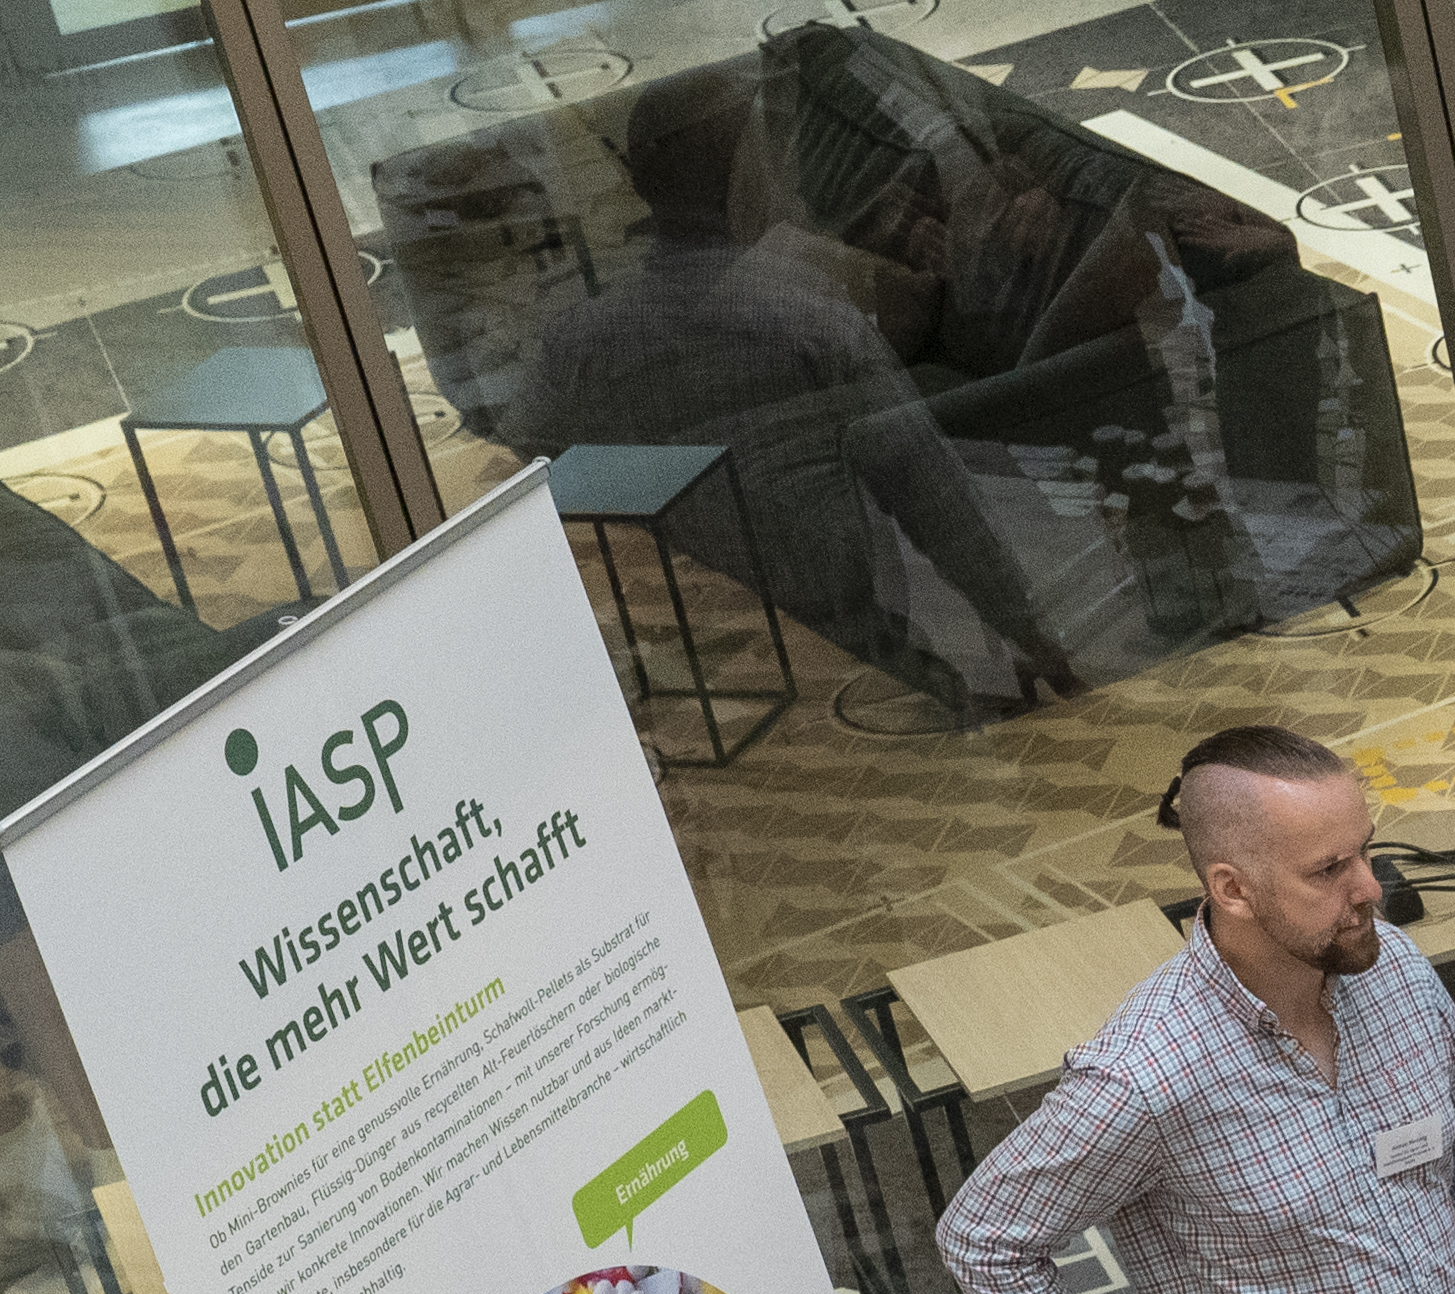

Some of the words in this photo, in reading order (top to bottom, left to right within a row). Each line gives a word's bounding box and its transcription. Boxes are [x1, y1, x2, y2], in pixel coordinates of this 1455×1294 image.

[199, 1052, 262, 1118] die
[264, 974, 362, 1071] mehr
[360, 900, 462, 993] Wert
[462, 808, 587, 927] schafft
[237, 797, 503, 1000] Wissenschaft,
[193, 1121, 310, 1218] Innovation
[311, 1078, 363, 1132] statt
[361, 975, 506, 1093] Elfenbeinturm
[207, 1229, 228, 1250] Ob
[226, 1167, 312, 1236] Mini-Brownies
[310, 1152, 329, 1173] für
[330, 1133, 356, 1159] eine
[356, 1084, 422, 1144] genussvolle
[420, 1040, 485, 1091] Ernährung,
[481, 969, 575, 1045] Schafwoll-Pellets
[573, 956, 592, 977] als
[589, 921, 635, 964] Substrat
[633, 910, 650, 930] für
[218, 1252, 243, 1277] den
[243, 1204, 310, 1257] Gartenbau,
[309, 1134, 397, 1207] Flüssig-Dünger
[399, 1117, 422, 1141] aus
[423, 1074, 480, 1123] recycelten
[481, 1001, 576, 1080] Alt-Feuerlöschern
[577, 979, 601, 1006] oder
[602, 935, 661, 986] biologische
[614, 1138, 690, 1205] Ernährung
